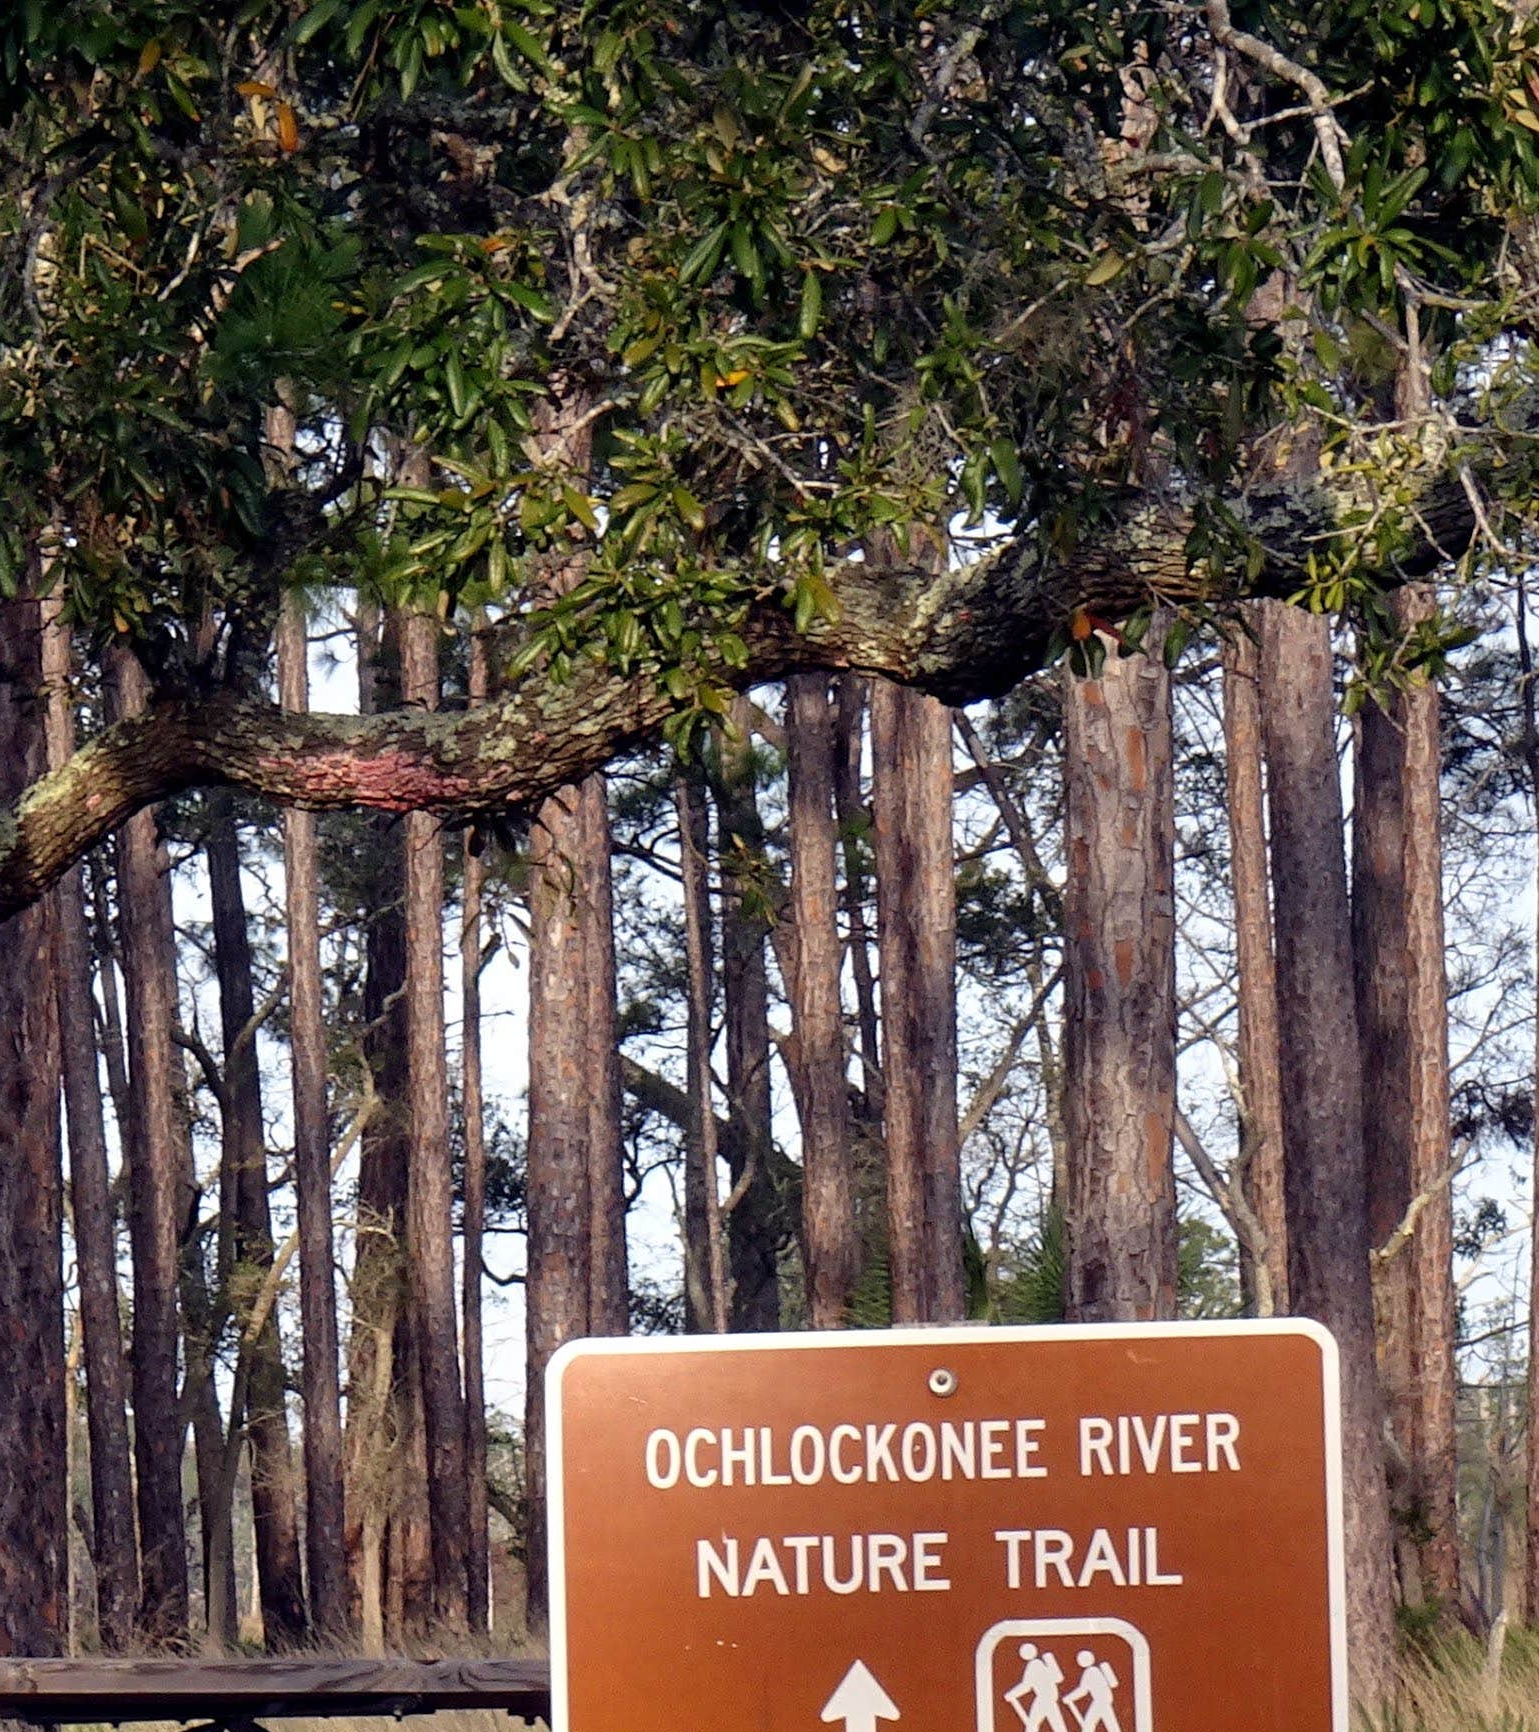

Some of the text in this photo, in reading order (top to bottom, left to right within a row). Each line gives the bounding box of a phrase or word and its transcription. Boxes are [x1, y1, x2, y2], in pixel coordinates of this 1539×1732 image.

[645, 1412, 1242, 1489] OCHLOCKONEE RIVER
[696, 1526, 1184, 1599] NATURE TRAIL
